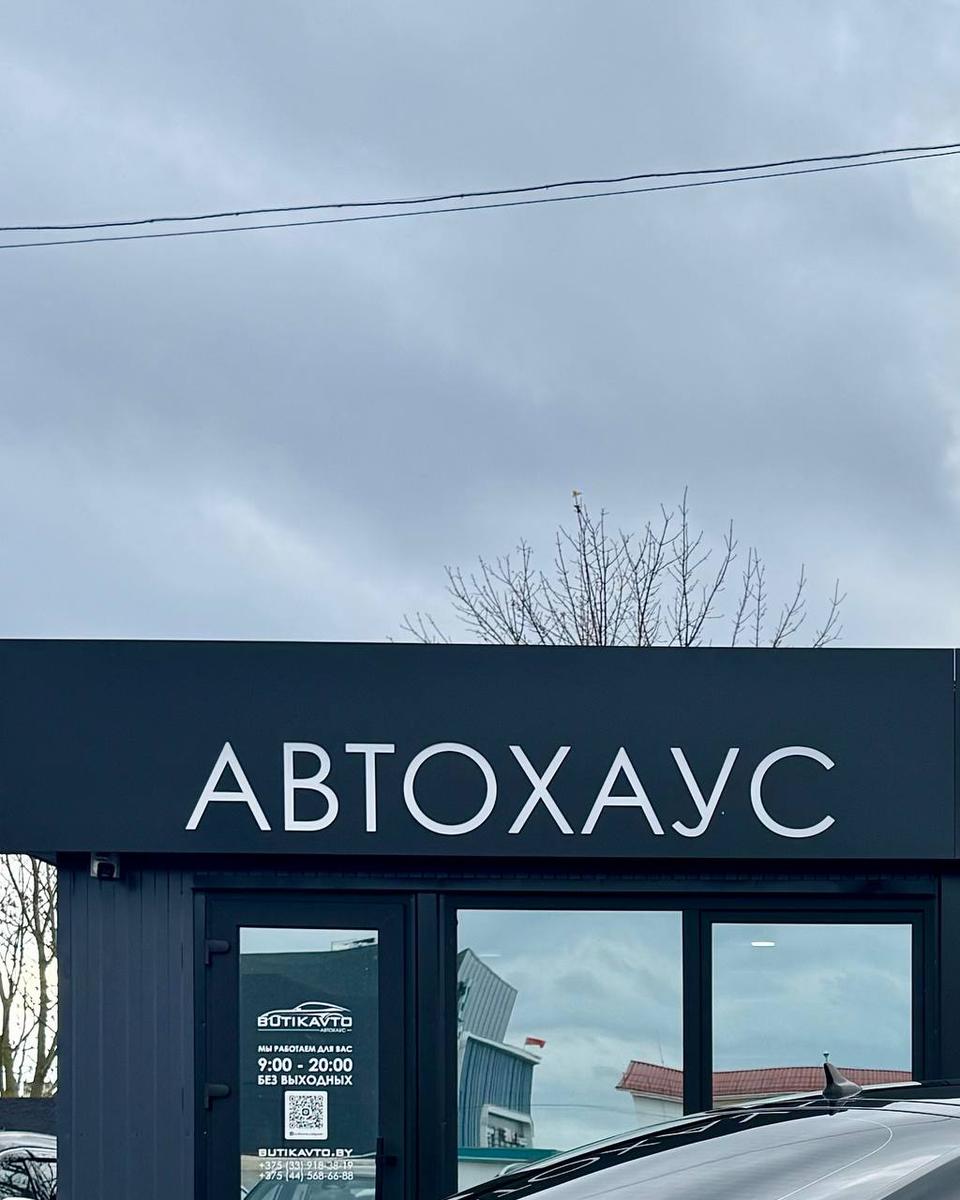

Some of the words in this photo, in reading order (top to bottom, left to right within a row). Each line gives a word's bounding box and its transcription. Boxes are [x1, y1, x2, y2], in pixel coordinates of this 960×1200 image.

[185, 740, 836, 839] АВТОХАУС
[257, 1016, 353, 1027] BUTIKAVTO
[257, 1045, 273, 1053] МЫ
[274, 1045, 316, 1053] РАБОТАЕМ
[317, 1045, 334, 1053] ДЛЯ
[335, 1045, 353, 1053] ВАС
[257, 1057, 293, 1072] 9:00
[308, 1057, 353, 1072] 20:00
[257, 1075, 278, 1085] БЕЗ
[280, 1075, 353, 1086] ВЫХОДНЫХ
[258, 1148, 353, 1157] BUTIKAVTO.BY
[259, 1161, 283, 1170] +375
[285, 1161, 304, 1171] (33)
[306, 1161, 354, 1170] 918-38-19
[259, 1171, 283, 1180] +375
[285, 1171, 304, 1182] (44)
[306, 1171, 354, 1180] 568-66-88
